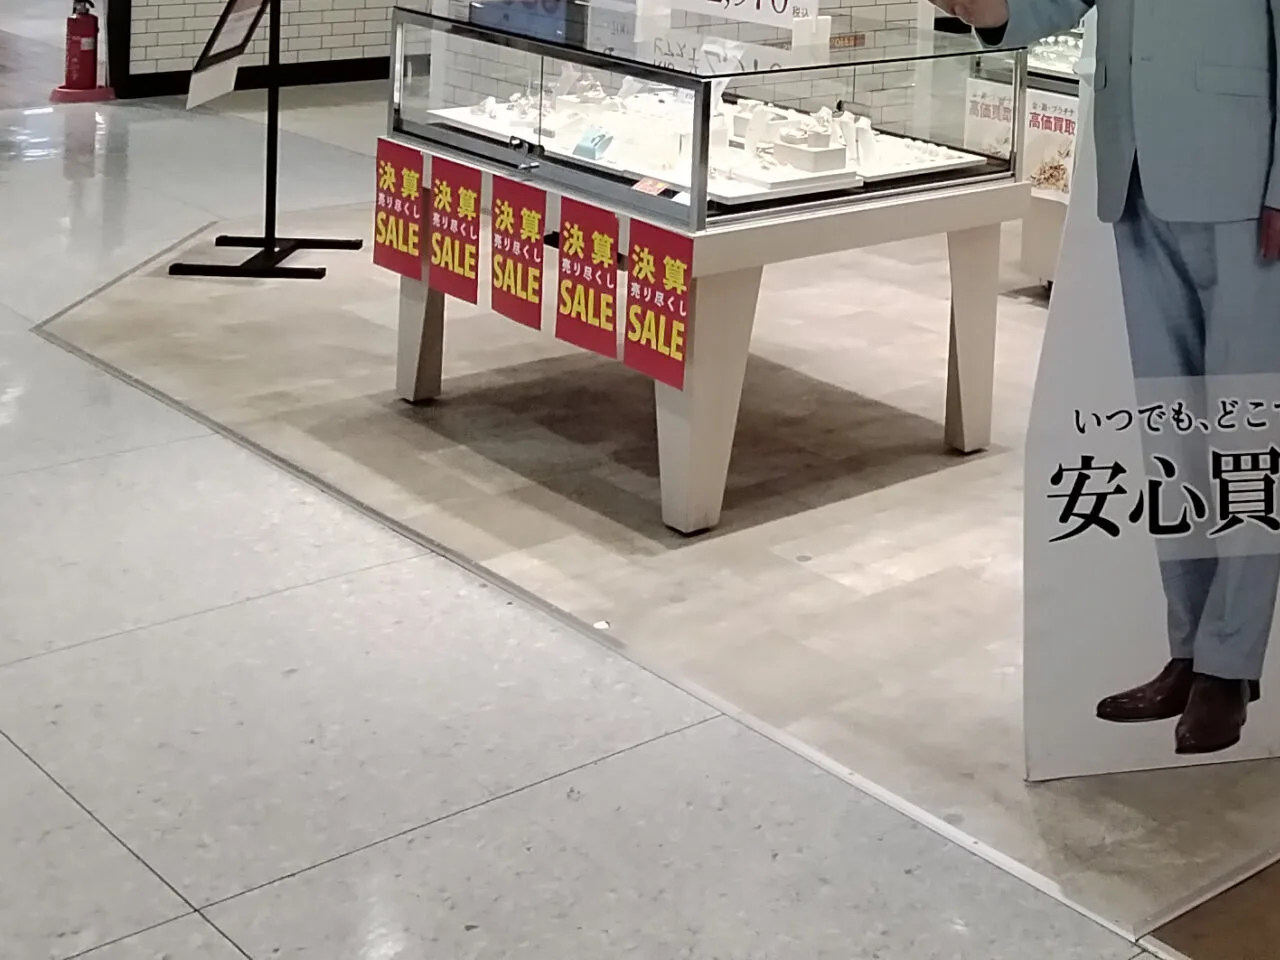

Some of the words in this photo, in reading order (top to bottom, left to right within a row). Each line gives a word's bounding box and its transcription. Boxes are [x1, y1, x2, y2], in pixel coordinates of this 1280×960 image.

[792, 6, 810, 17] 税込
[1028, 112, 1076, 136] 高価買取
[379, 160, 420, 200] 決算
[434, 179, 477, 221] 決算
[377, 192, 420, 219] 売り尽くし
[432, 212, 478, 240] 売り尽くし
[495, 198, 542, 243] 決算
[376, 212, 419, 257] SALE
[431, 232, 477, 279] SALE
[493, 233, 542, 263] 売り尽くし
[563, 221, 614, 269] 決算
[493, 255, 540, 304] SALE
[561, 257, 615, 289] 売り尽くし
[632, 244, 688, 295] 決算
[559, 280, 613, 332] SALE
[630, 281, 687, 317] 売り尽くし
[627, 304, 685, 362] SALE
